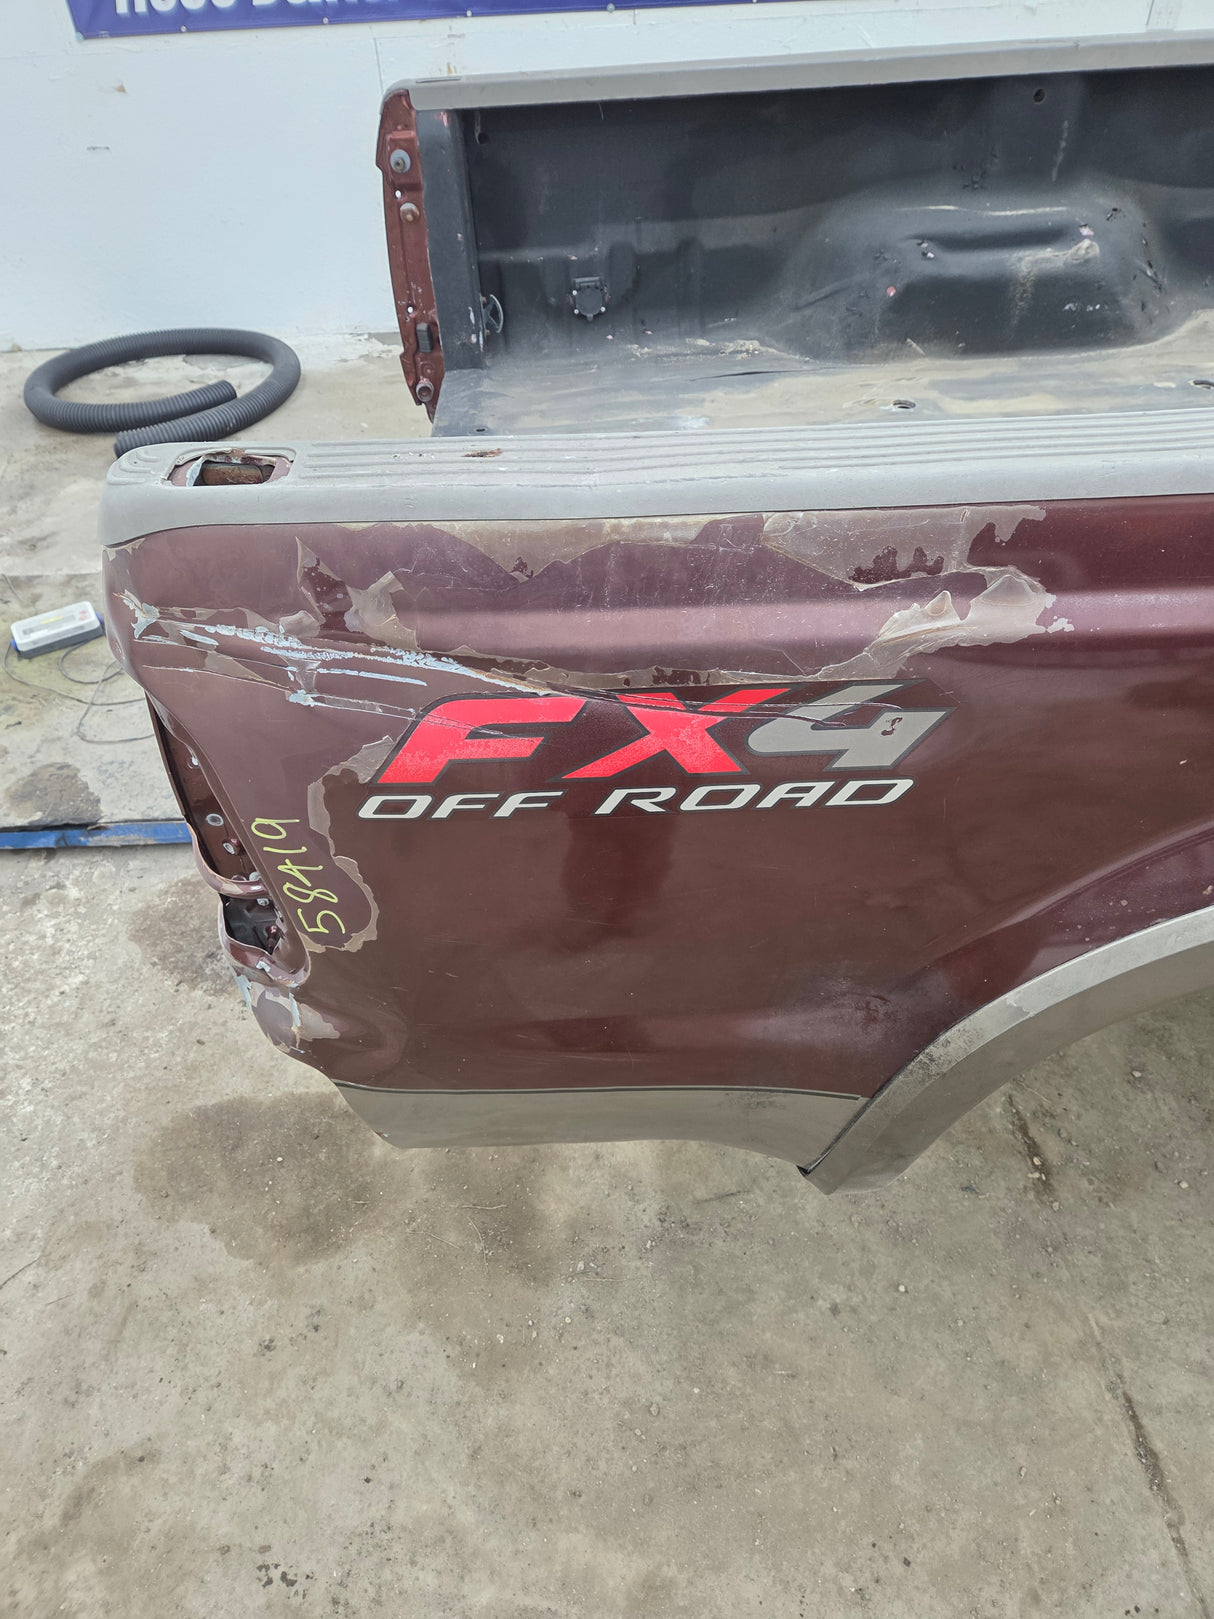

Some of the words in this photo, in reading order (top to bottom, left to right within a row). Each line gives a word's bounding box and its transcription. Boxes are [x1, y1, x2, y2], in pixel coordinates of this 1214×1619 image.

[372, 681, 954, 784] FX4
[358, 791, 564, 819] OFF
[595, 779, 914, 815] ROAD
[251, 818, 346, 934] 58419
